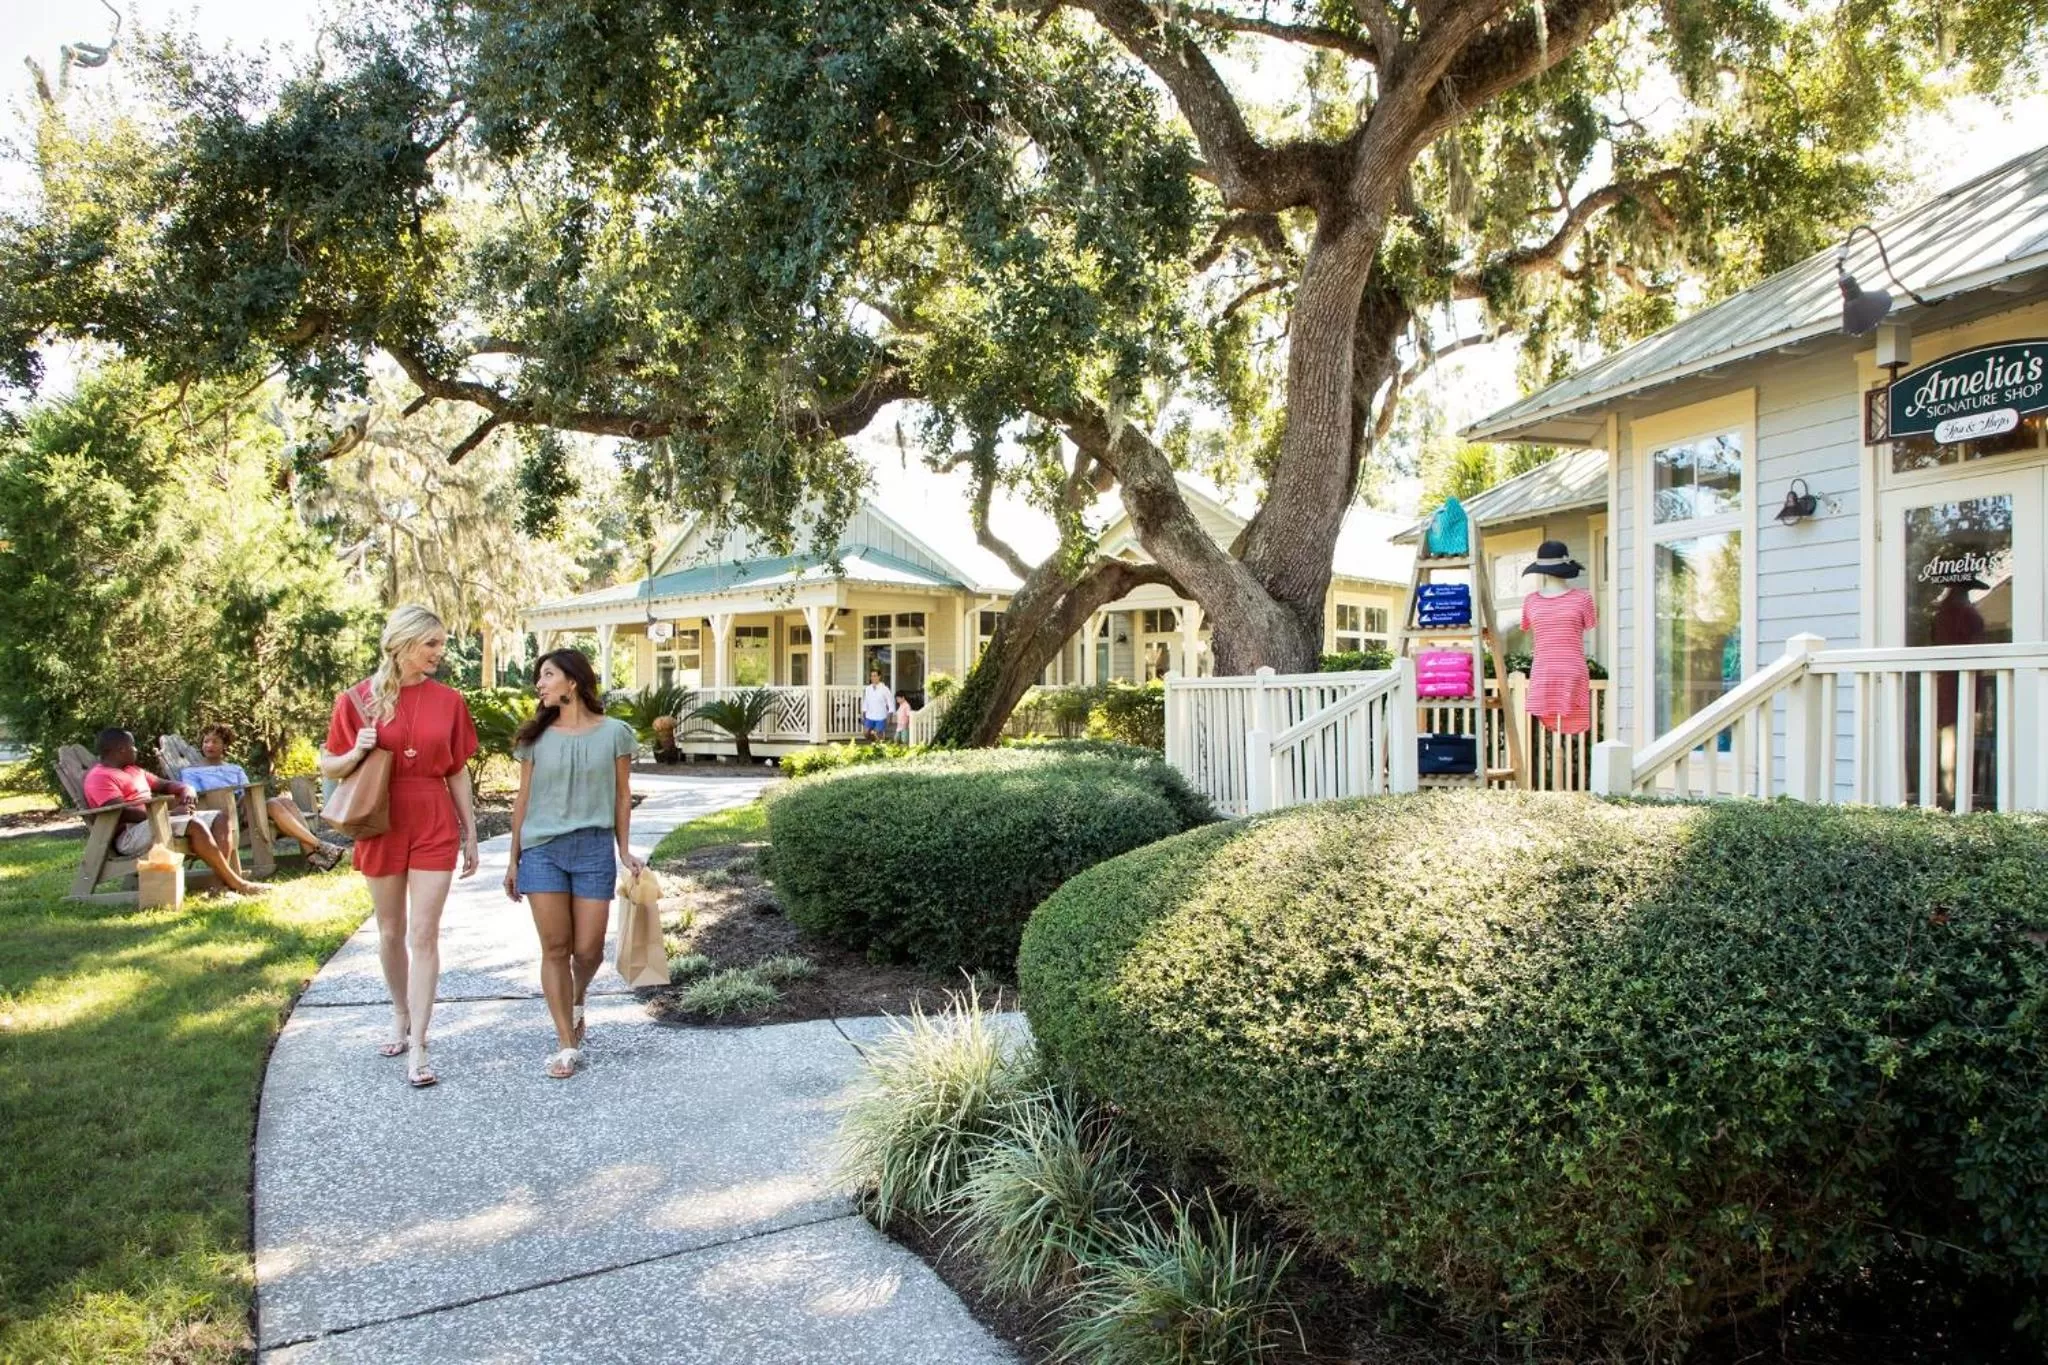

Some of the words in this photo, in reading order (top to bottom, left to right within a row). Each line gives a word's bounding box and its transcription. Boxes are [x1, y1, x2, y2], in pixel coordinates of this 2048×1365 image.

[1905, 350, 2043, 417] Amelia's
[1926, 393, 1998, 419] SIGNATURE
[2004, 382, 2043, 402] SHOP
[1918, 552, 1997, 582] Amelia's
[1931, 573, 1972, 584] SIGNATURE
